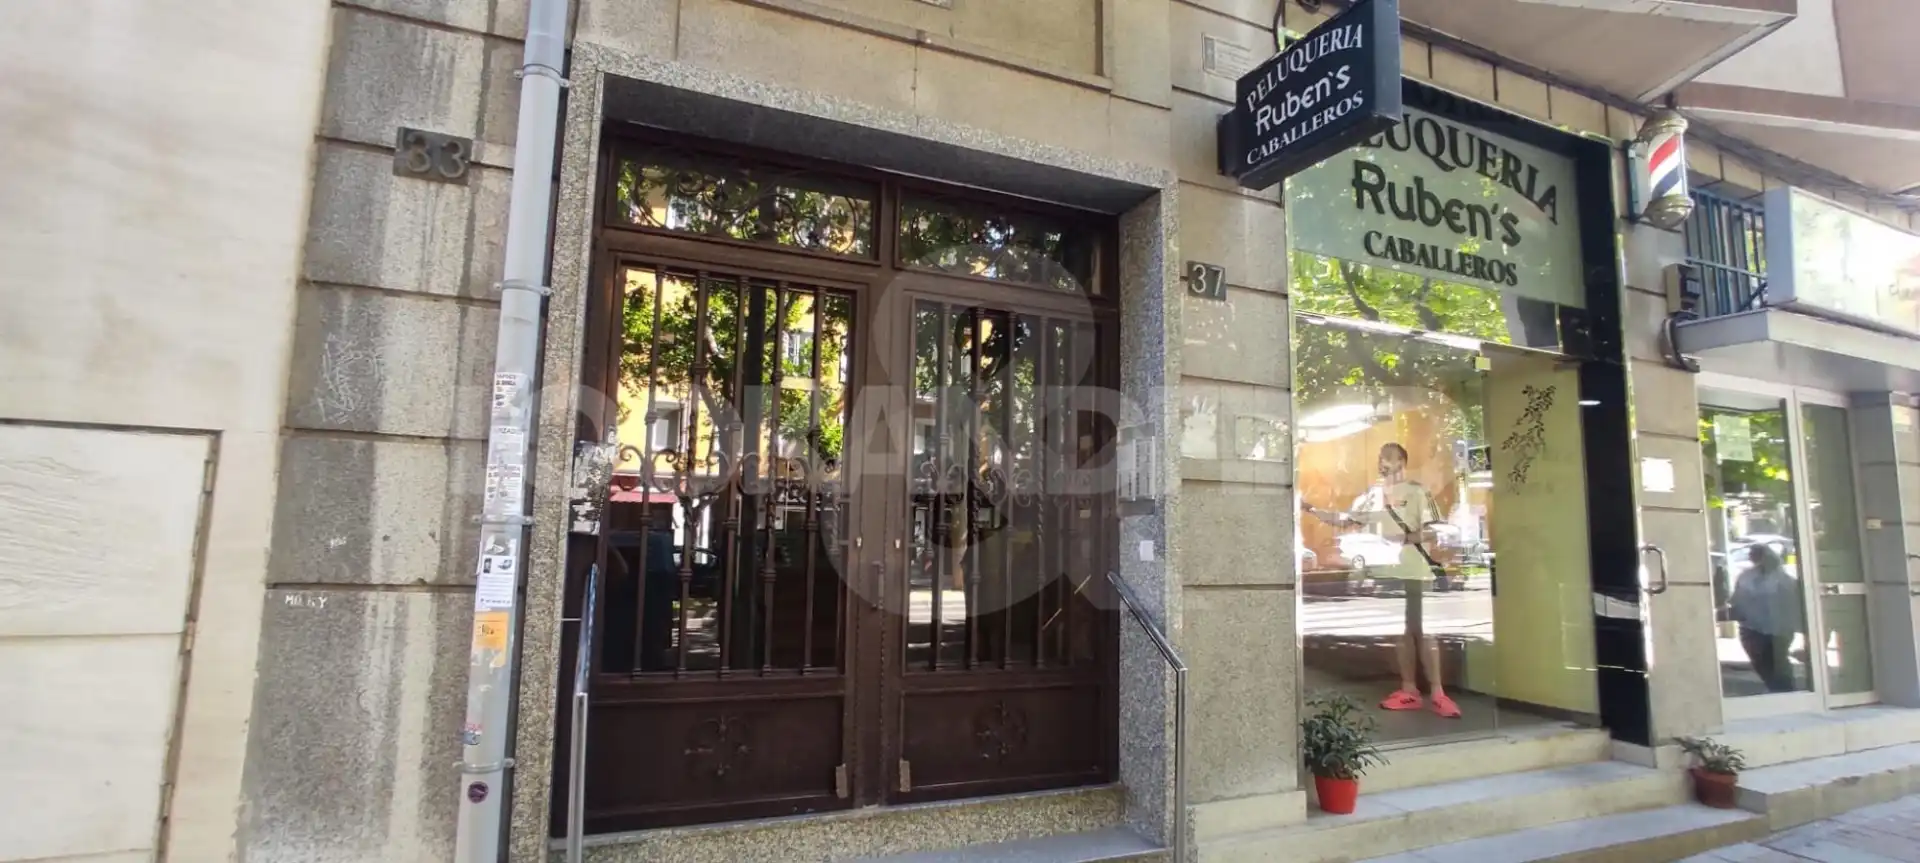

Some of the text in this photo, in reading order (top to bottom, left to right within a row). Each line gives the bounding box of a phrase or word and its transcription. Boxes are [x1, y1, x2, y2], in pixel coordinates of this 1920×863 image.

[1246, 24, 1363, 113] PELUQUERIA
[406, 131, 465, 178] 33
[1246, 90, 1364, 164] CABALLEROS
[1352, 159, 1521, 247] Ruben's
[1191, 264, 1224, 297] 37
[1363, 230, 1518, 287] CABALLEROS
